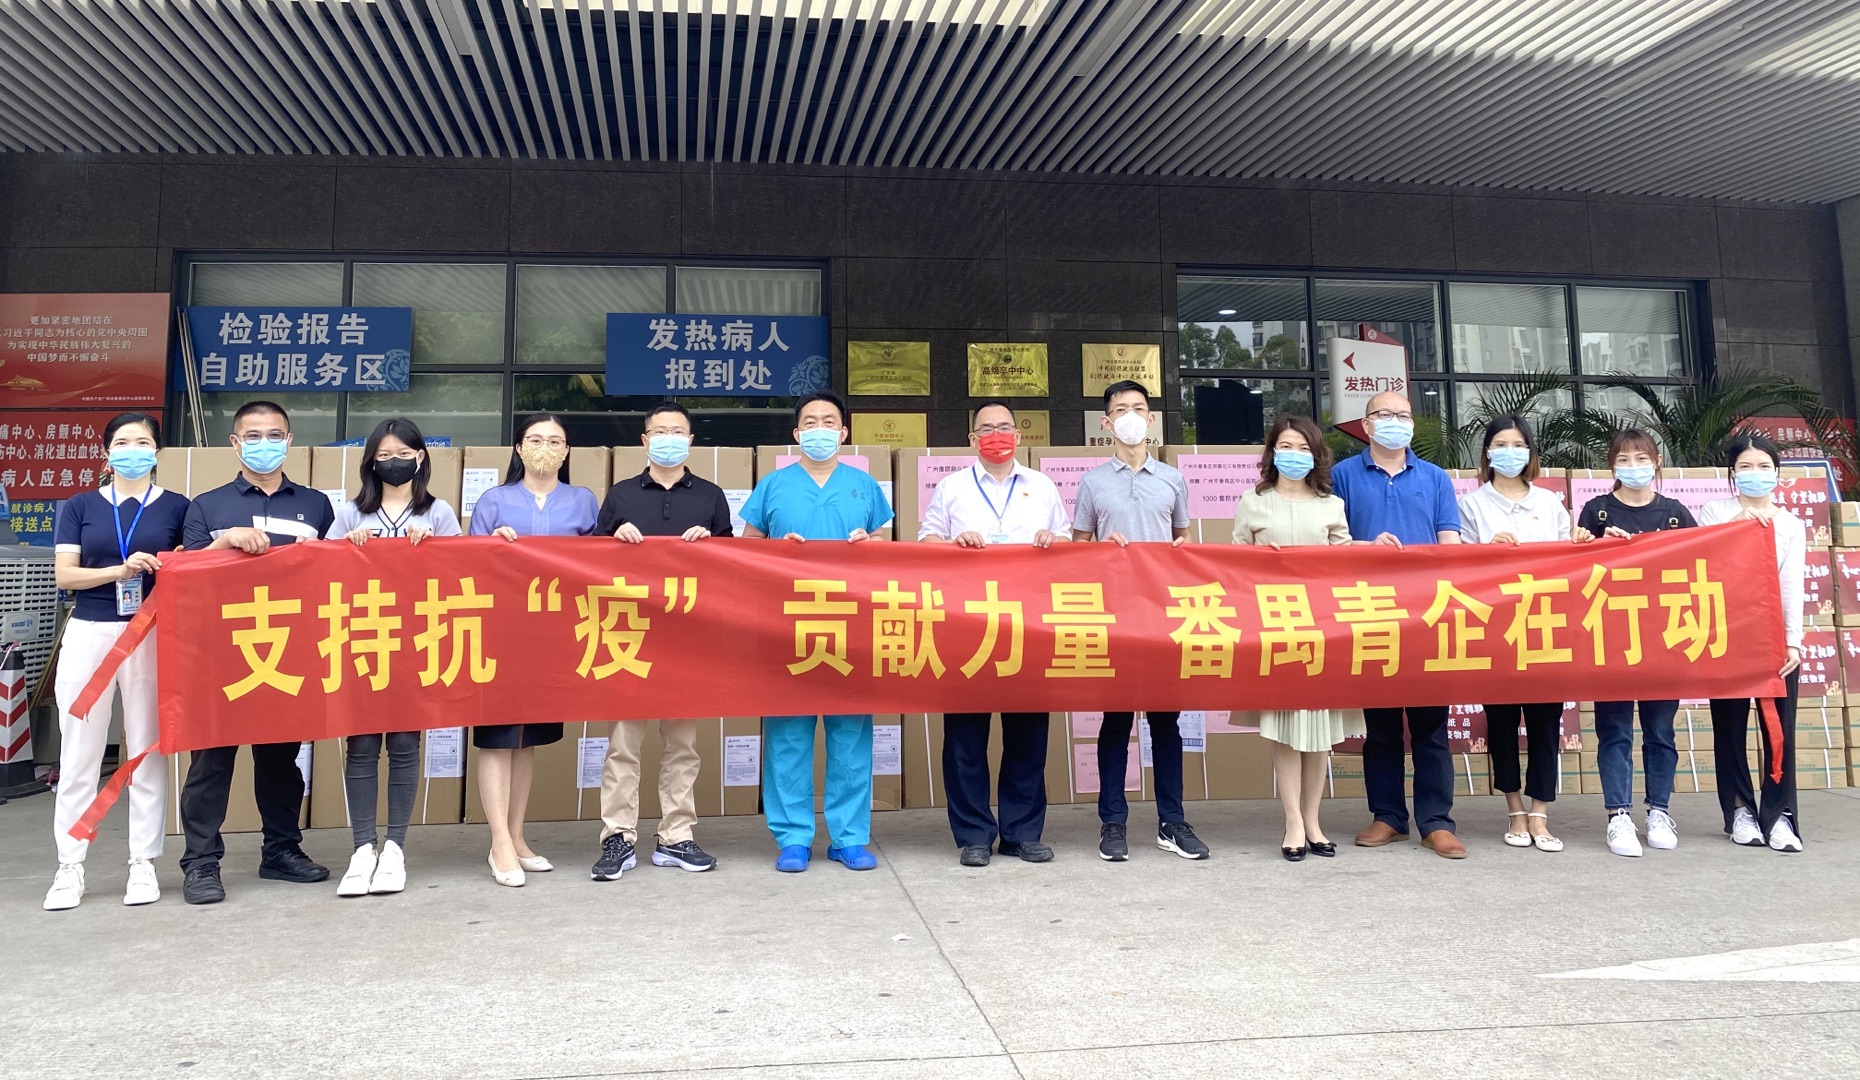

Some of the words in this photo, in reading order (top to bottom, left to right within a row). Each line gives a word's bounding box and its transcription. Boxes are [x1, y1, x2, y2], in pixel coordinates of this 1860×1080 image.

[30, 315, 113, 325] 更加紧密地团结在
[0, 327, 148, 337] 习近平同志为核心的党中央周围
[218, 312, 369, 345] 检验报告
[647, 318, 790, 353] 发热病人
[7, 340, 132, 349] 为实现中华民族伟大复兴的
[27, 352, 110, 362] 中国梦而不懈奋斗
[200, 352, 386, 386] 自助服务区
[665, 358, 772, 390] 报到处
[982, 366, 1034, 376] 高级卒中中心
[1344, 376, 1404, 392] 发热门诊
[11, 502, 55, 514] 就诊病人
[10, 516, 53, 533] 接送点
[221, 576, 698, 701] 支持抗“疫”
[783, 579, 1117, 680] 贡献力量
[1165, 557, 1730, 679] 番禺青企在行动
[1798, 674, 1827, 683] 疫物资
